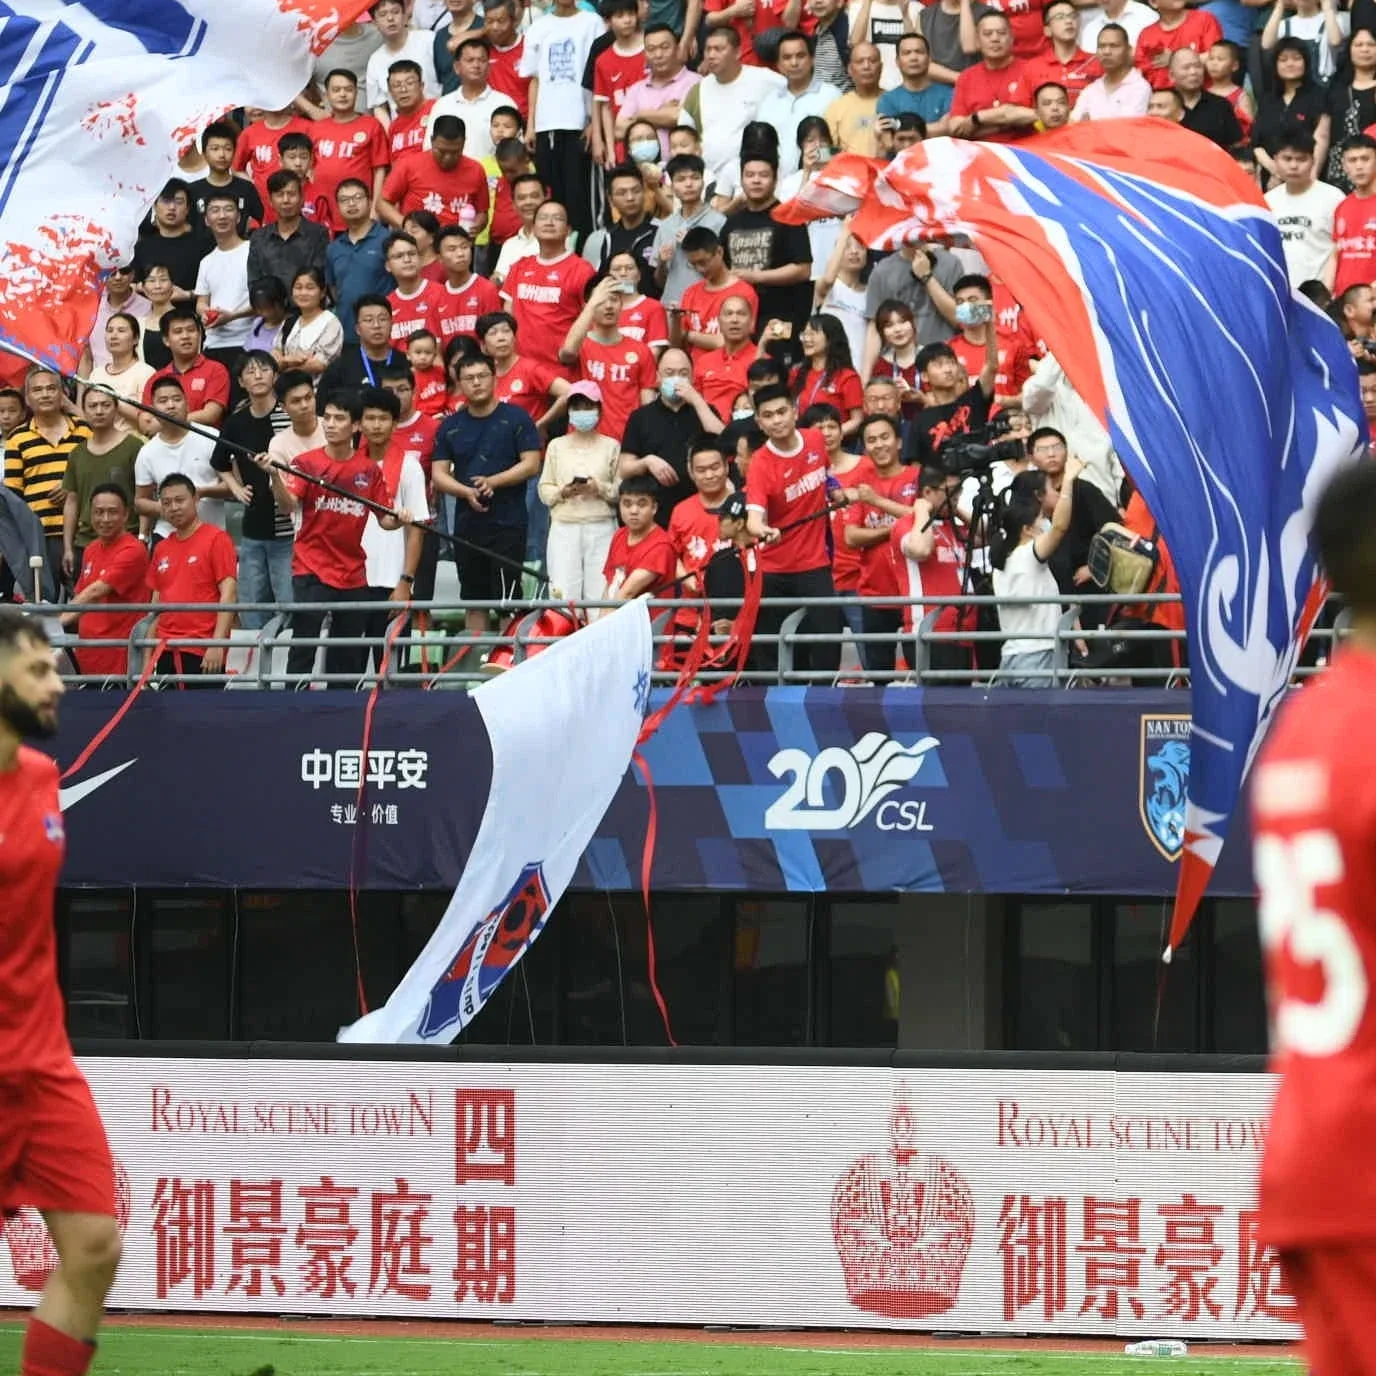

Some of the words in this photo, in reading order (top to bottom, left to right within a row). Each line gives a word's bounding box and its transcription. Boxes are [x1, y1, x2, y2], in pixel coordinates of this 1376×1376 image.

[301, 748, 428, 790] 中国平安
[876, 801, 934, 832] CSL
[151, 1084, 246, 1135] ROYAL
[252, 1102, 336, 1136] SCENE
[996, 1099, 1093, 1149] ROYAL
[1109, 1116, 1200, 1151] SCENE
[150, 1175, 433, 1302] 御景豪庭
